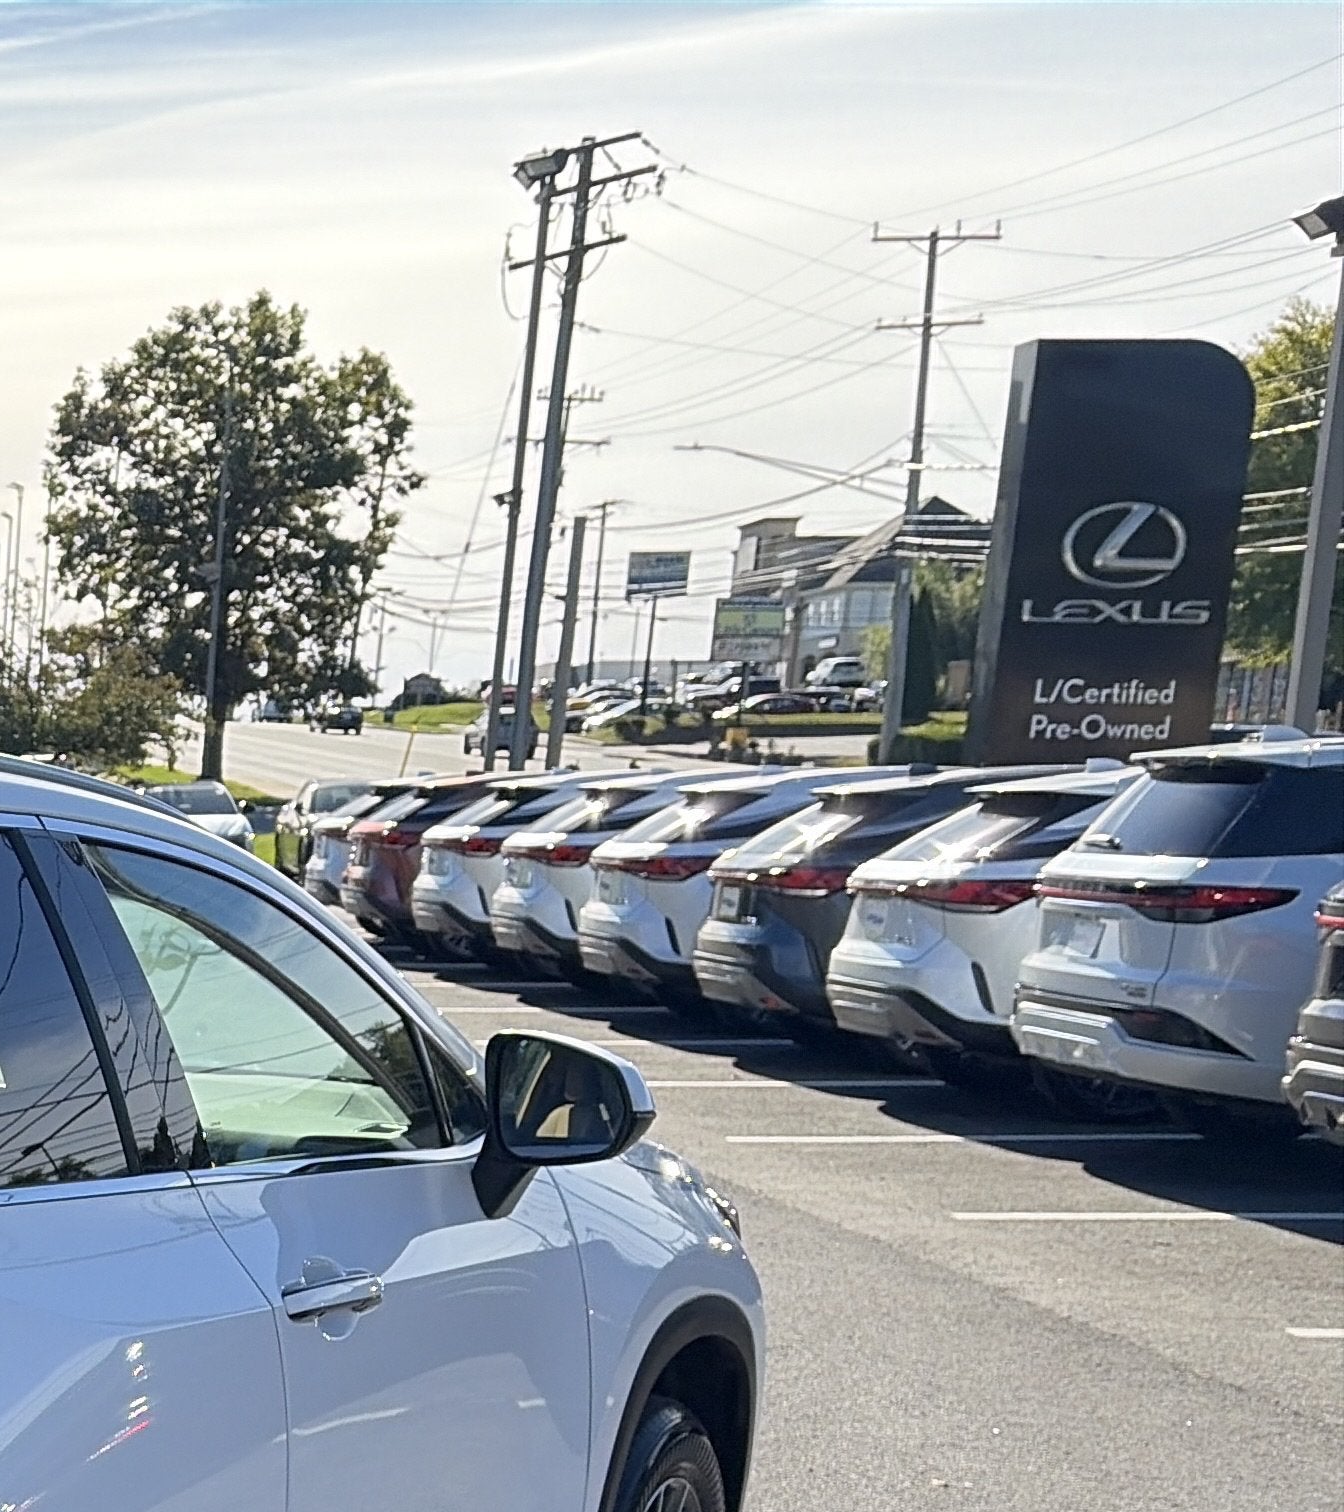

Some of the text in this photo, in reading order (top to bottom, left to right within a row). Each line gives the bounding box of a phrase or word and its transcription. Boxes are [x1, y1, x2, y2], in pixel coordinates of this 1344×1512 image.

[1021, 599, 1211, 624] LEXUS
[1033, 678, 1176, 704] L/Certified
[1029, 714, 1171, 740] Pre-Owned
